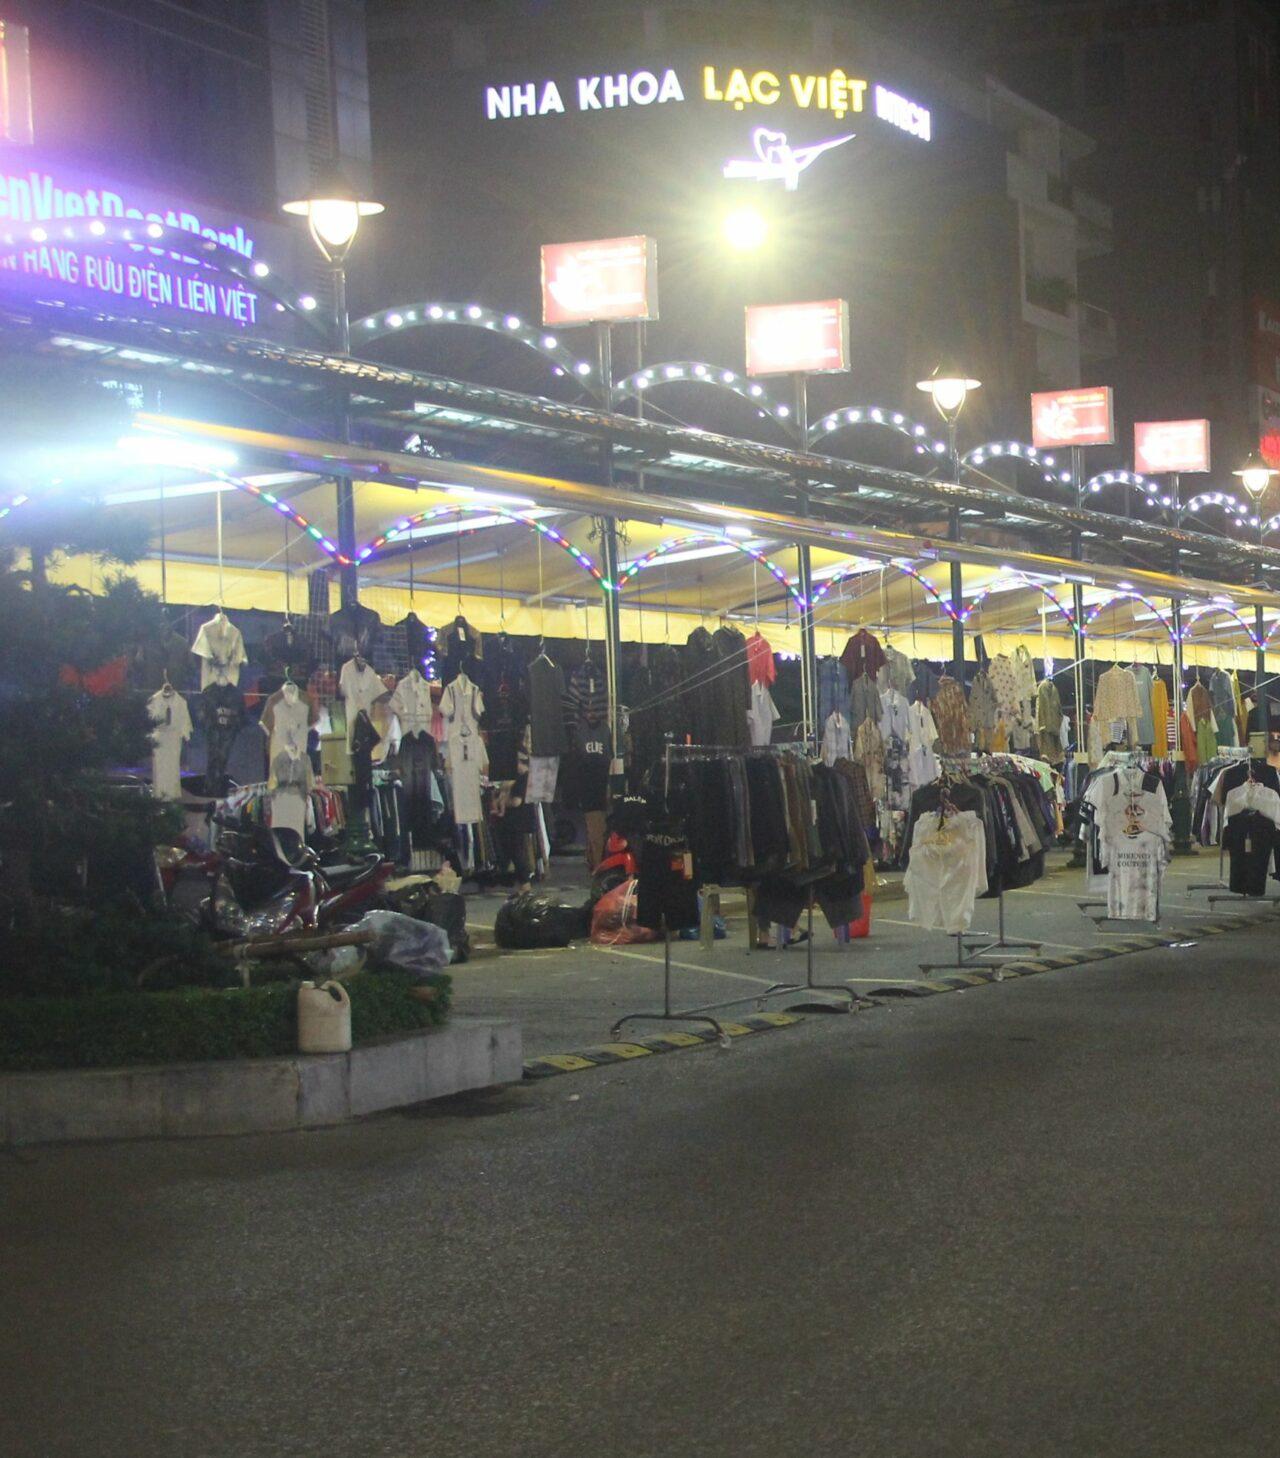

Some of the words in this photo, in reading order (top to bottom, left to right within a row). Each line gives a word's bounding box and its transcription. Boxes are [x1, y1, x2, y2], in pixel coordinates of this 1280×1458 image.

[487, 80, 565, 119] NHA
[578, 69, 684, 111] KHOA
[704, 66, 780, 111] LẠC
[790, 69, 867, 118] VIỆT
[128, 263, 173, 307] ĐIỆN
[178, 273, 217, 315] LIÊN
[220, 283, 257, 327] VIỆT
